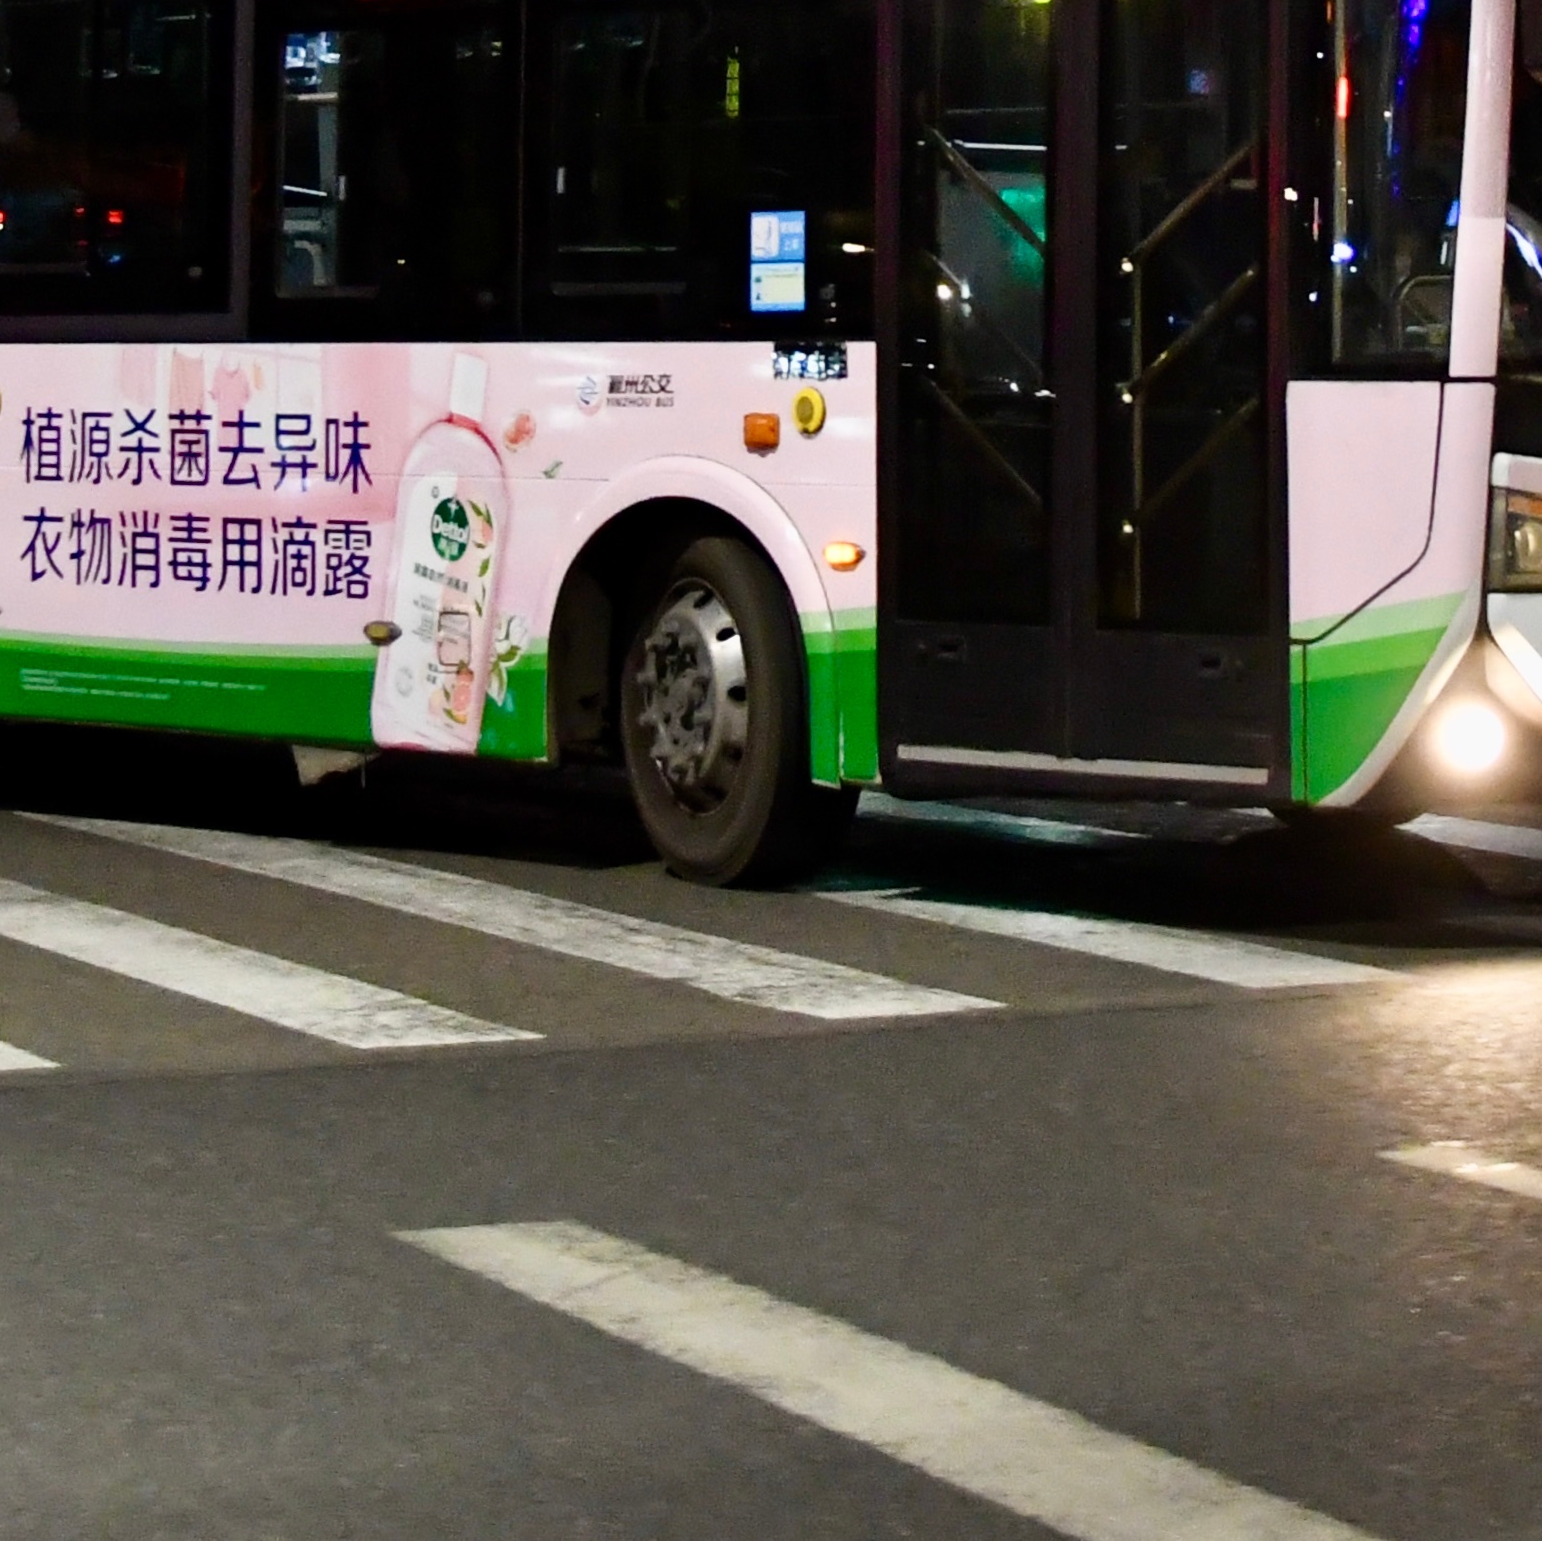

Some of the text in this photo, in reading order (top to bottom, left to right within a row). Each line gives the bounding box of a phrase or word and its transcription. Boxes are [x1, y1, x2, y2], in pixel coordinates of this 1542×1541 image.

[21, 407, 372, 494] 植源杀菌去异味
[21, 507, 372, 600] 衣物消毒用滴露
